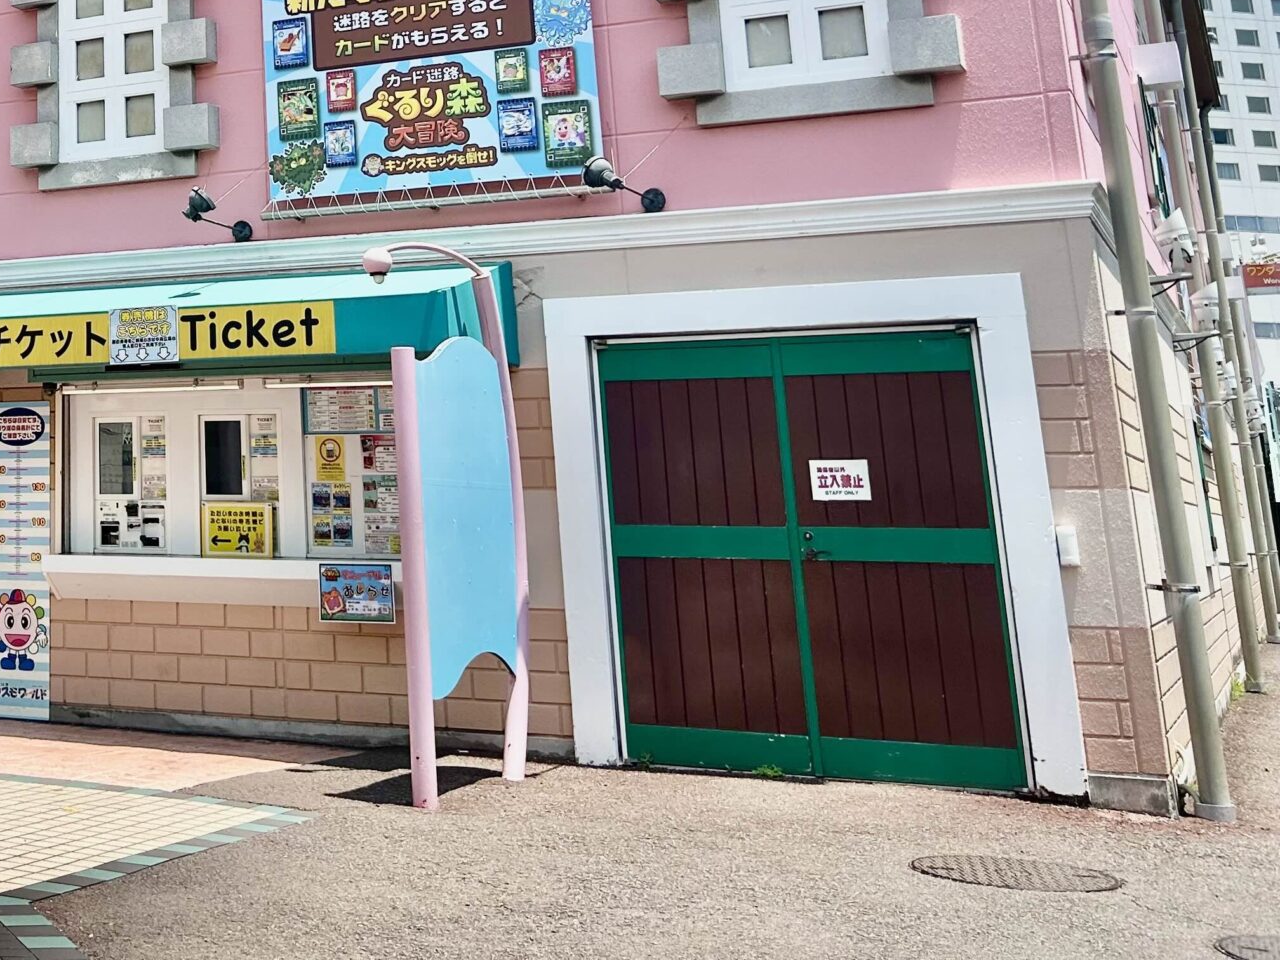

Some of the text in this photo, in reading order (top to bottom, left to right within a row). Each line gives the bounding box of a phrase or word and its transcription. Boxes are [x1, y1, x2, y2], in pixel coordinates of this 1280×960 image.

[335, 18, 505, 57] カードがもらえる！
[386, 66, 459, 88] カード迷路
[365, 78, 487, 123] ぐるり森
[388, 119, 465, 148] 大冒険
[117, 322, 170, 338] こちらです
[180, 307, 320, 351] Ticket
[32, 483, 46, 492] 130
[817, 474, 864, 489] 立入禁止
[32, 518, 46, 527] 110
[343, 584, 389, 599] おしらせ
